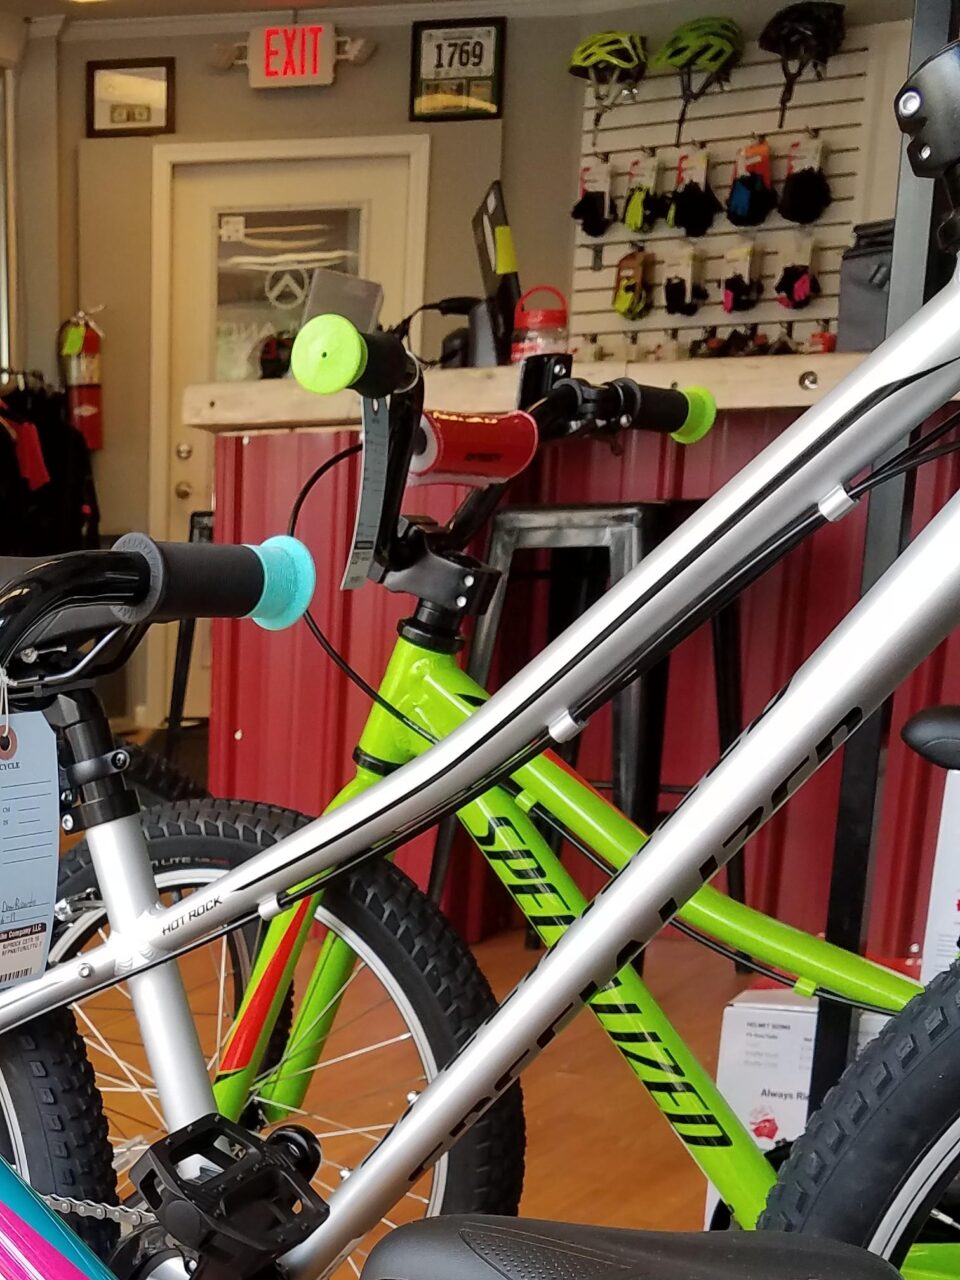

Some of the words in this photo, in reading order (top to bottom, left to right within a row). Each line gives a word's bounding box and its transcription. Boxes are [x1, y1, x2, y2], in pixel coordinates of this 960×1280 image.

[265, 27, 323, 77] EXIT
[434, 40, 484, 68] 1769
[162, 915, 185, 935] HOT
[189, 896, 222, 921] ROCK
[9, 927, 31, 938] Company
[32, 923, 42, 932] LLC
[761, 1088, 793, 1100] Always
